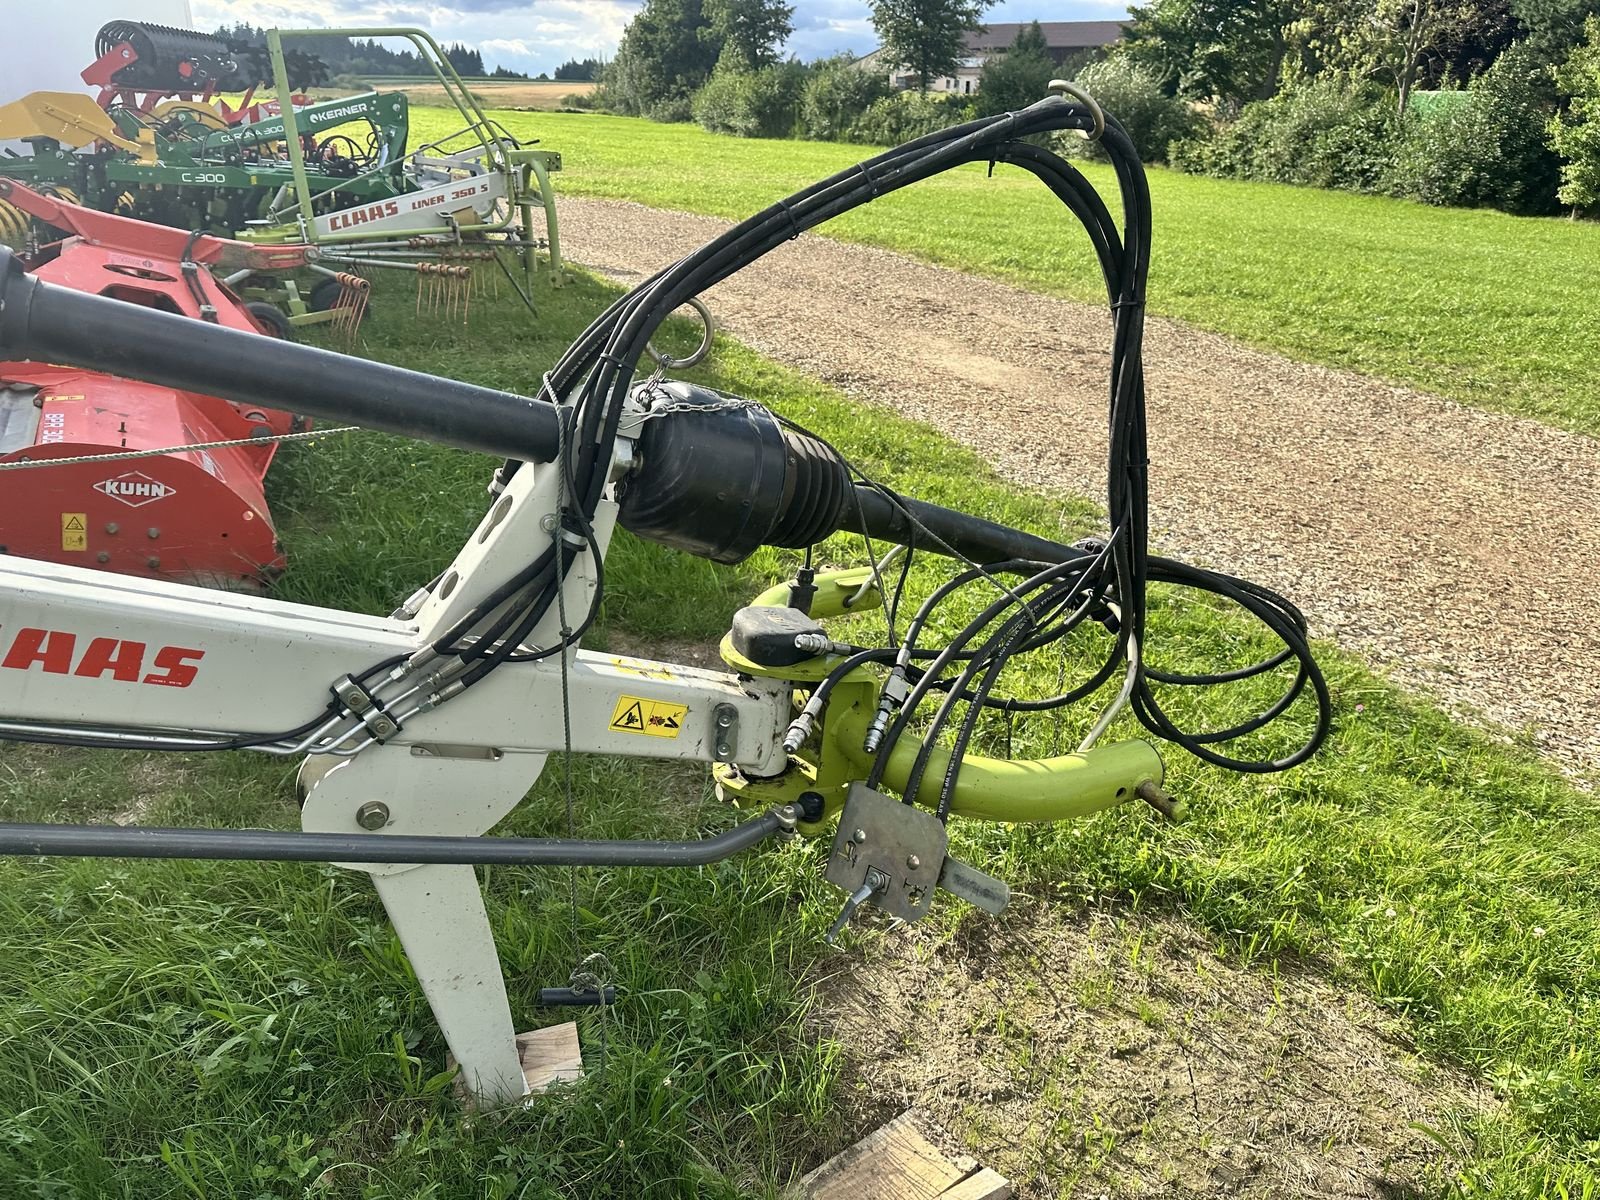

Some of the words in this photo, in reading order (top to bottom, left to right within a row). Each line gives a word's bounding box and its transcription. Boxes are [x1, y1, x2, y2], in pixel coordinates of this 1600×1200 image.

[318, 103, 367, 121] KERNER
[263, 125, 285, 135] 300
[181, 173, 192, 182] C
[195, 173, 225, 183] 300
[329, 201, 398, 231] CLAAS
[412, 194, 445, 210] LINER
[452, 187, 476, 200] 350
[44, 413, 65, 428] BPR
[105, 481, 165, 497] KUHN
[0, 625, 206, 688] AAS
